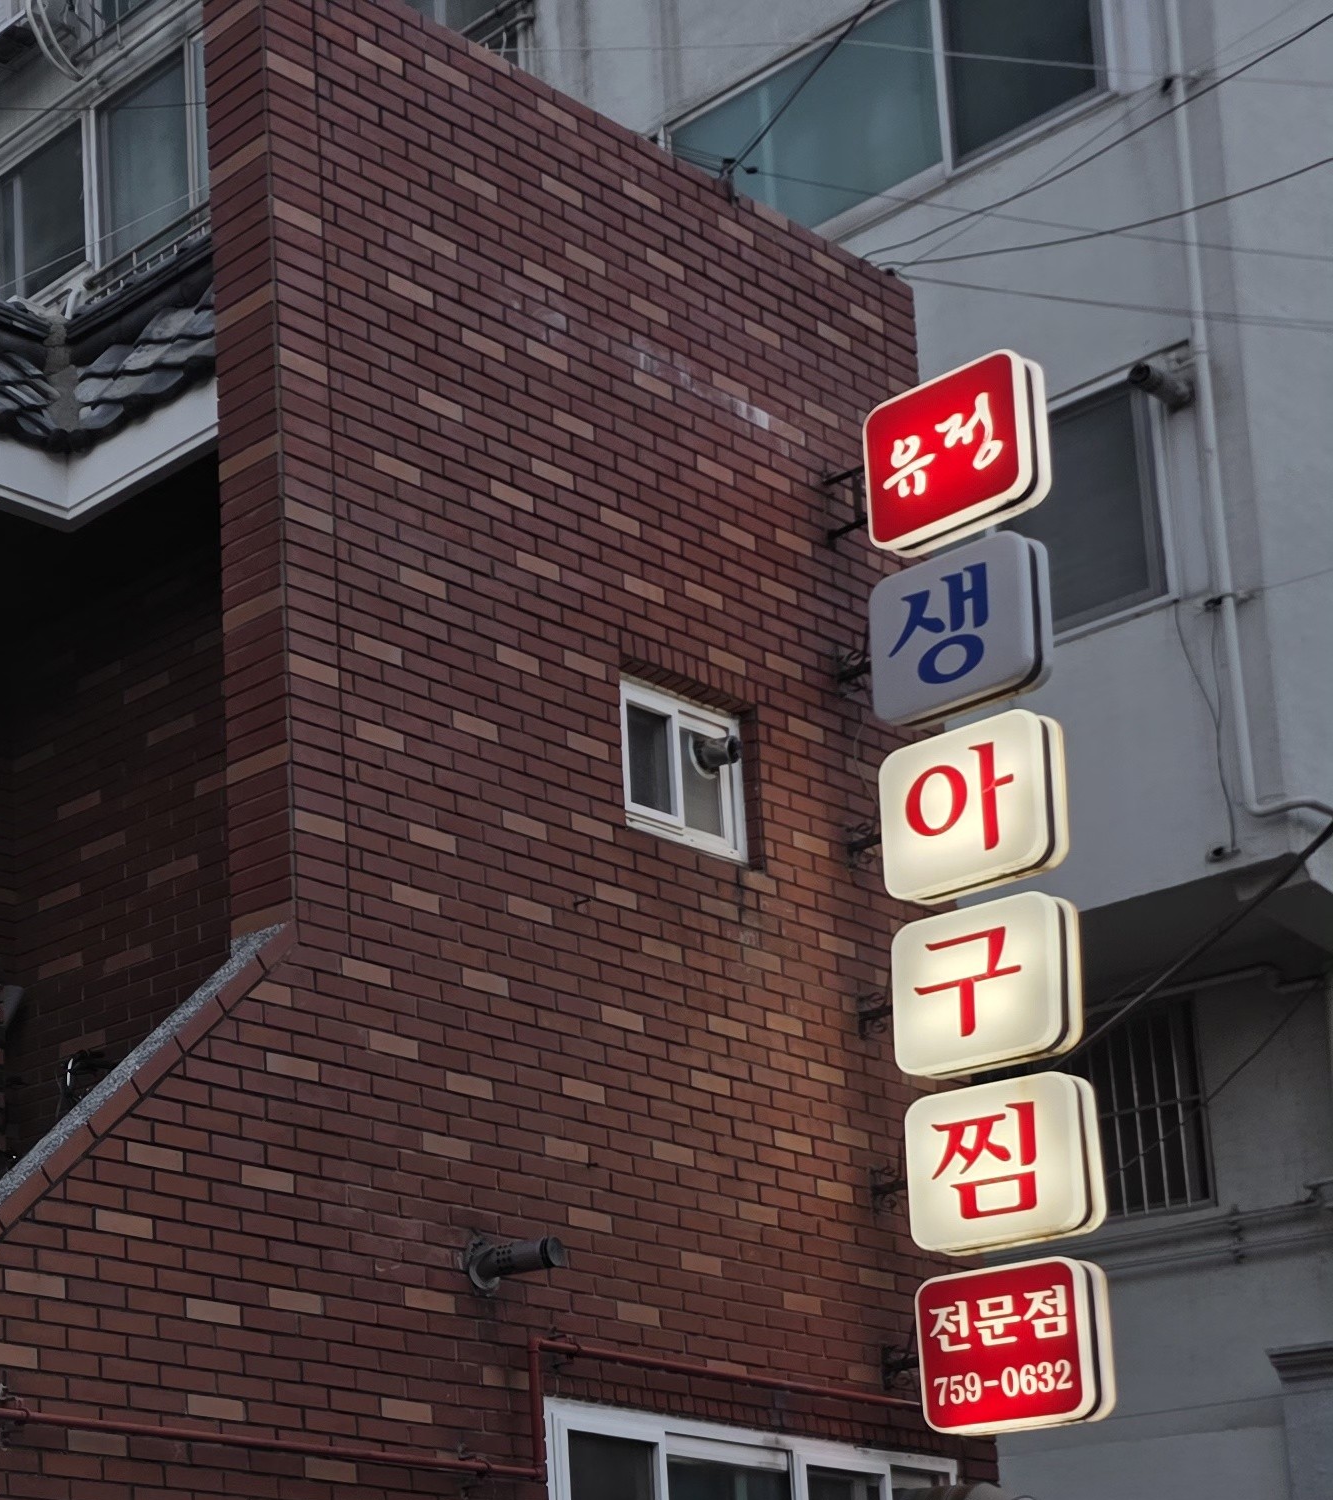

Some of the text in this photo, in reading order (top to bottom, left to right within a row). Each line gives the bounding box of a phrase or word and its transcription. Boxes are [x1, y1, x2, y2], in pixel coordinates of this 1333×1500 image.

[883, 391, 1003, 498] 유정
[929, 1284, 1070, 1354] 전문점
[933, 1359, 1073, 1408] 759-0632
